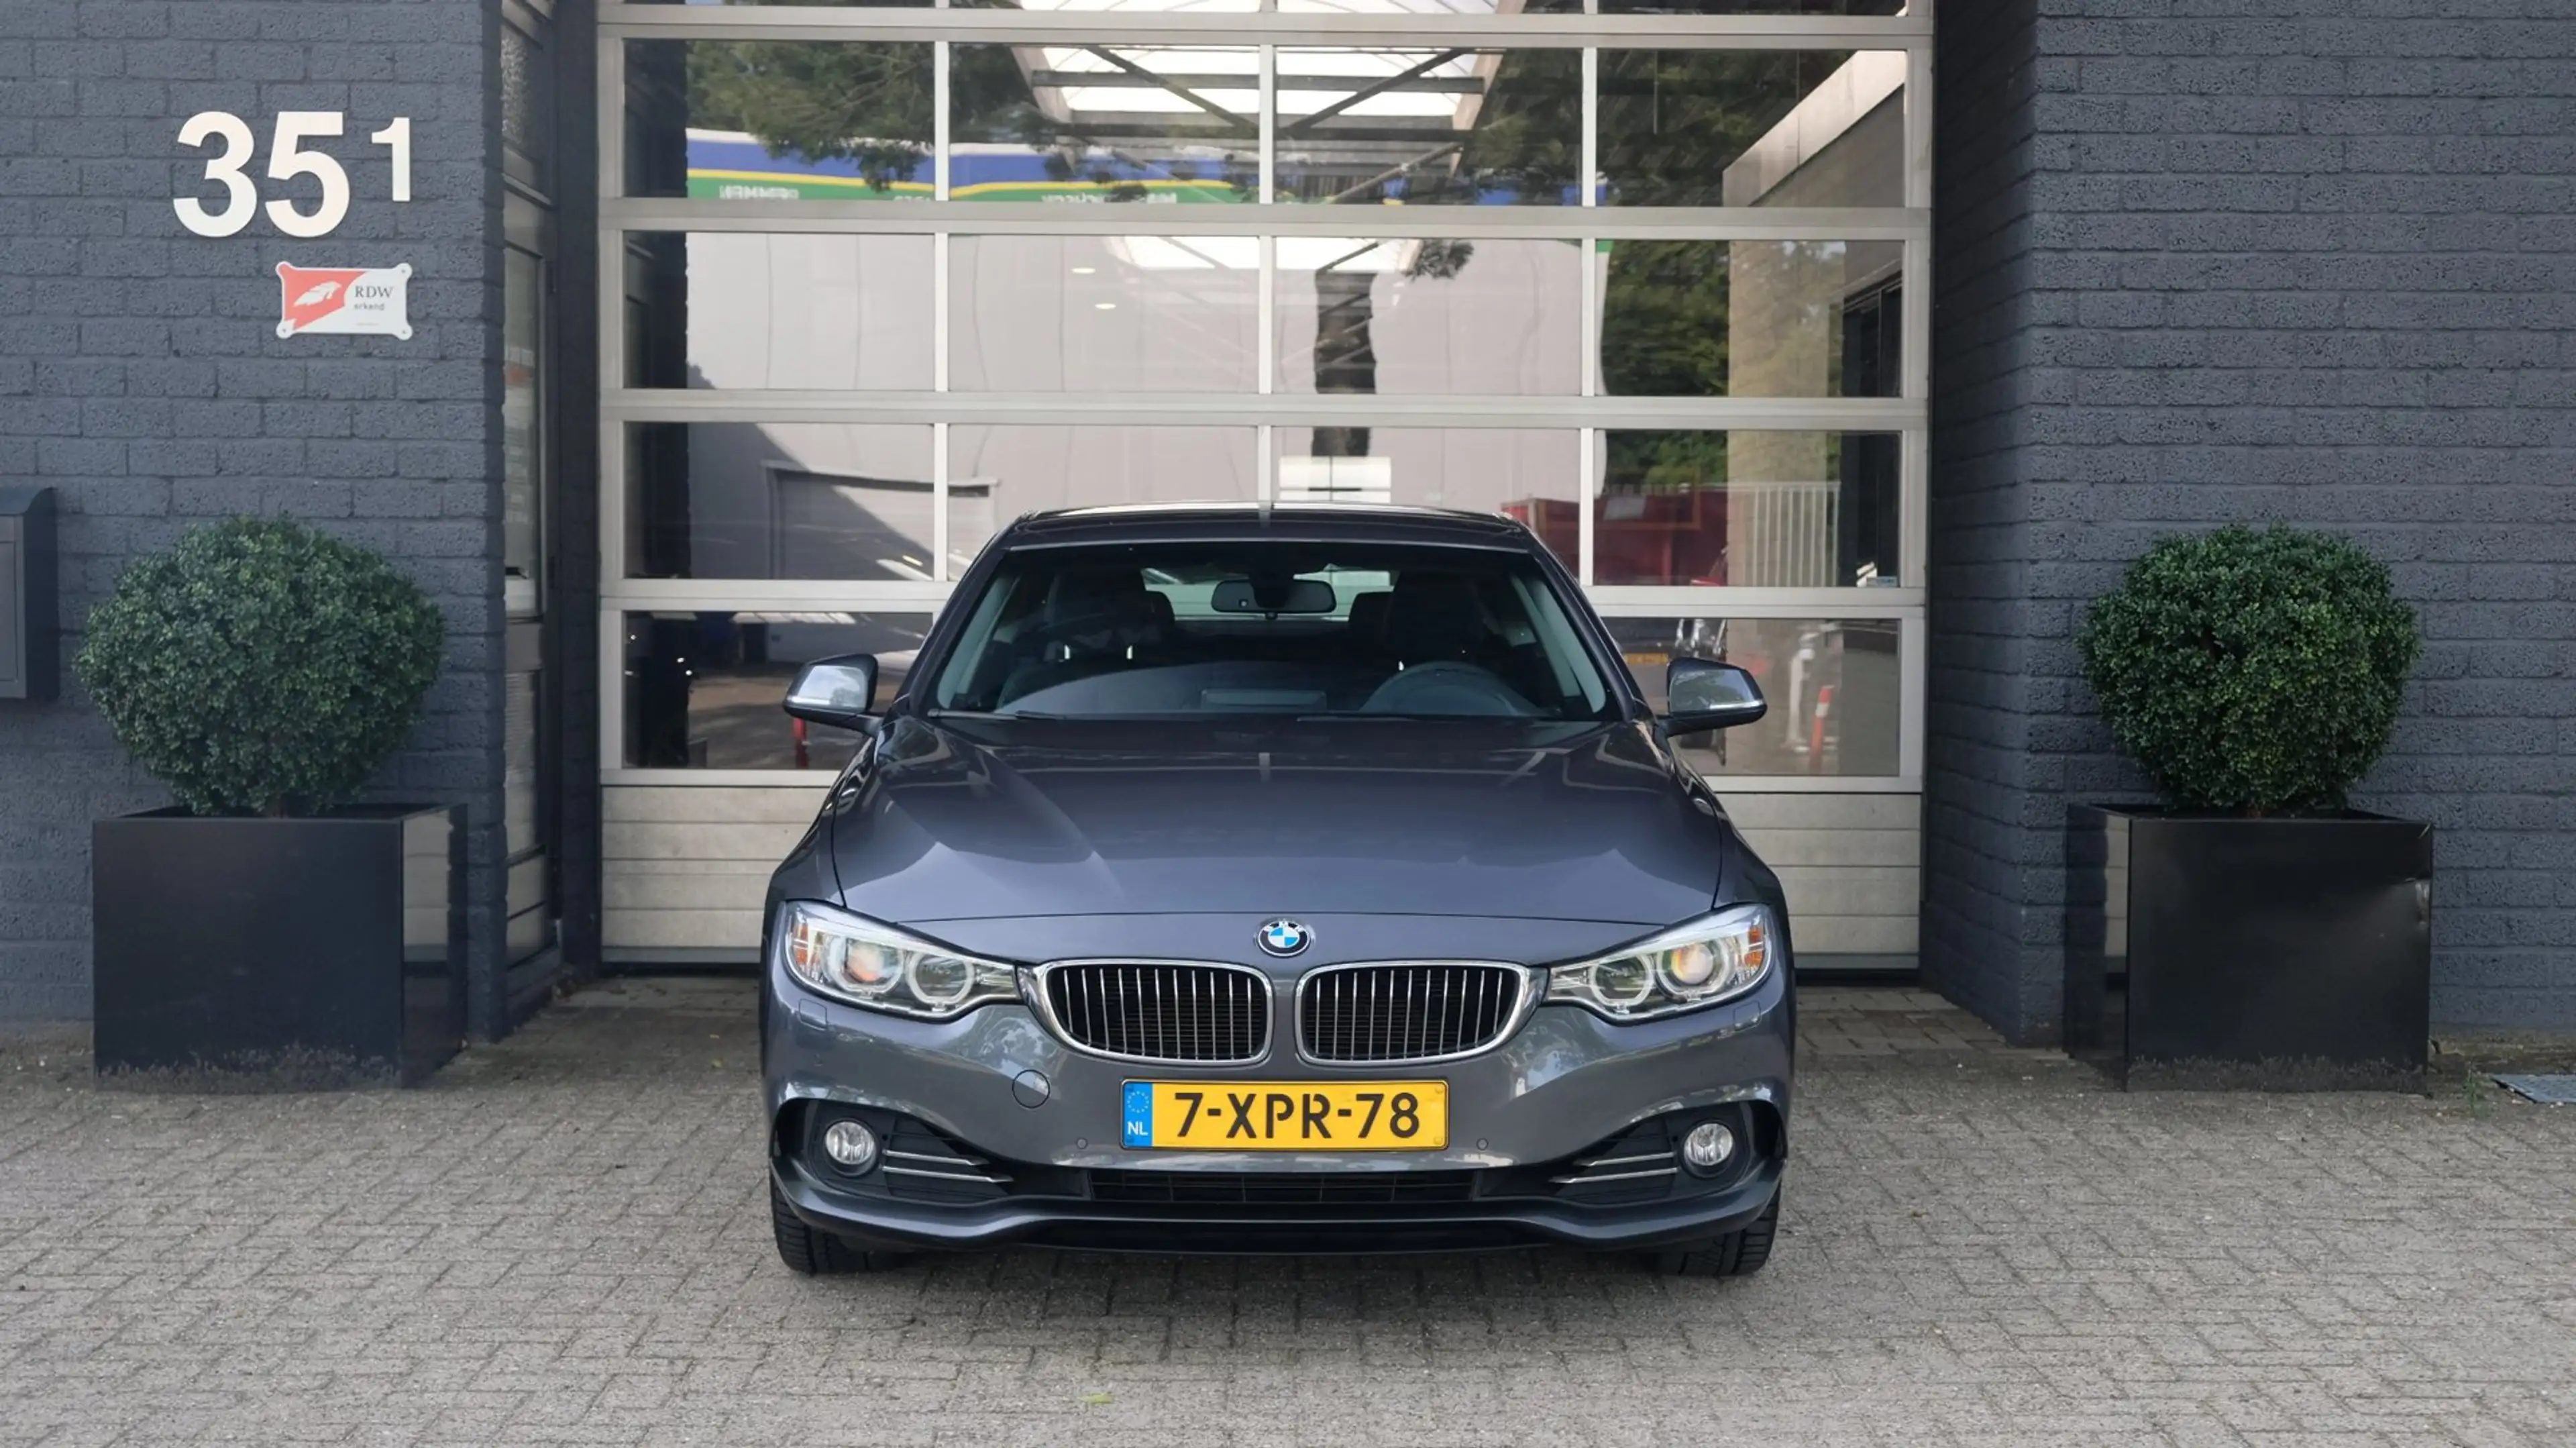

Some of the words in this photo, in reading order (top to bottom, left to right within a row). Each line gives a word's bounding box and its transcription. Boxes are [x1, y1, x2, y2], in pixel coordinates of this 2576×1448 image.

[354, 285, 394, 298] RDW
[354, 303, 385, 311] erkend
[1175, 1092, 1419, 1139] 7-XPR-78
[1127, 1121, 1148, 1135] NL
